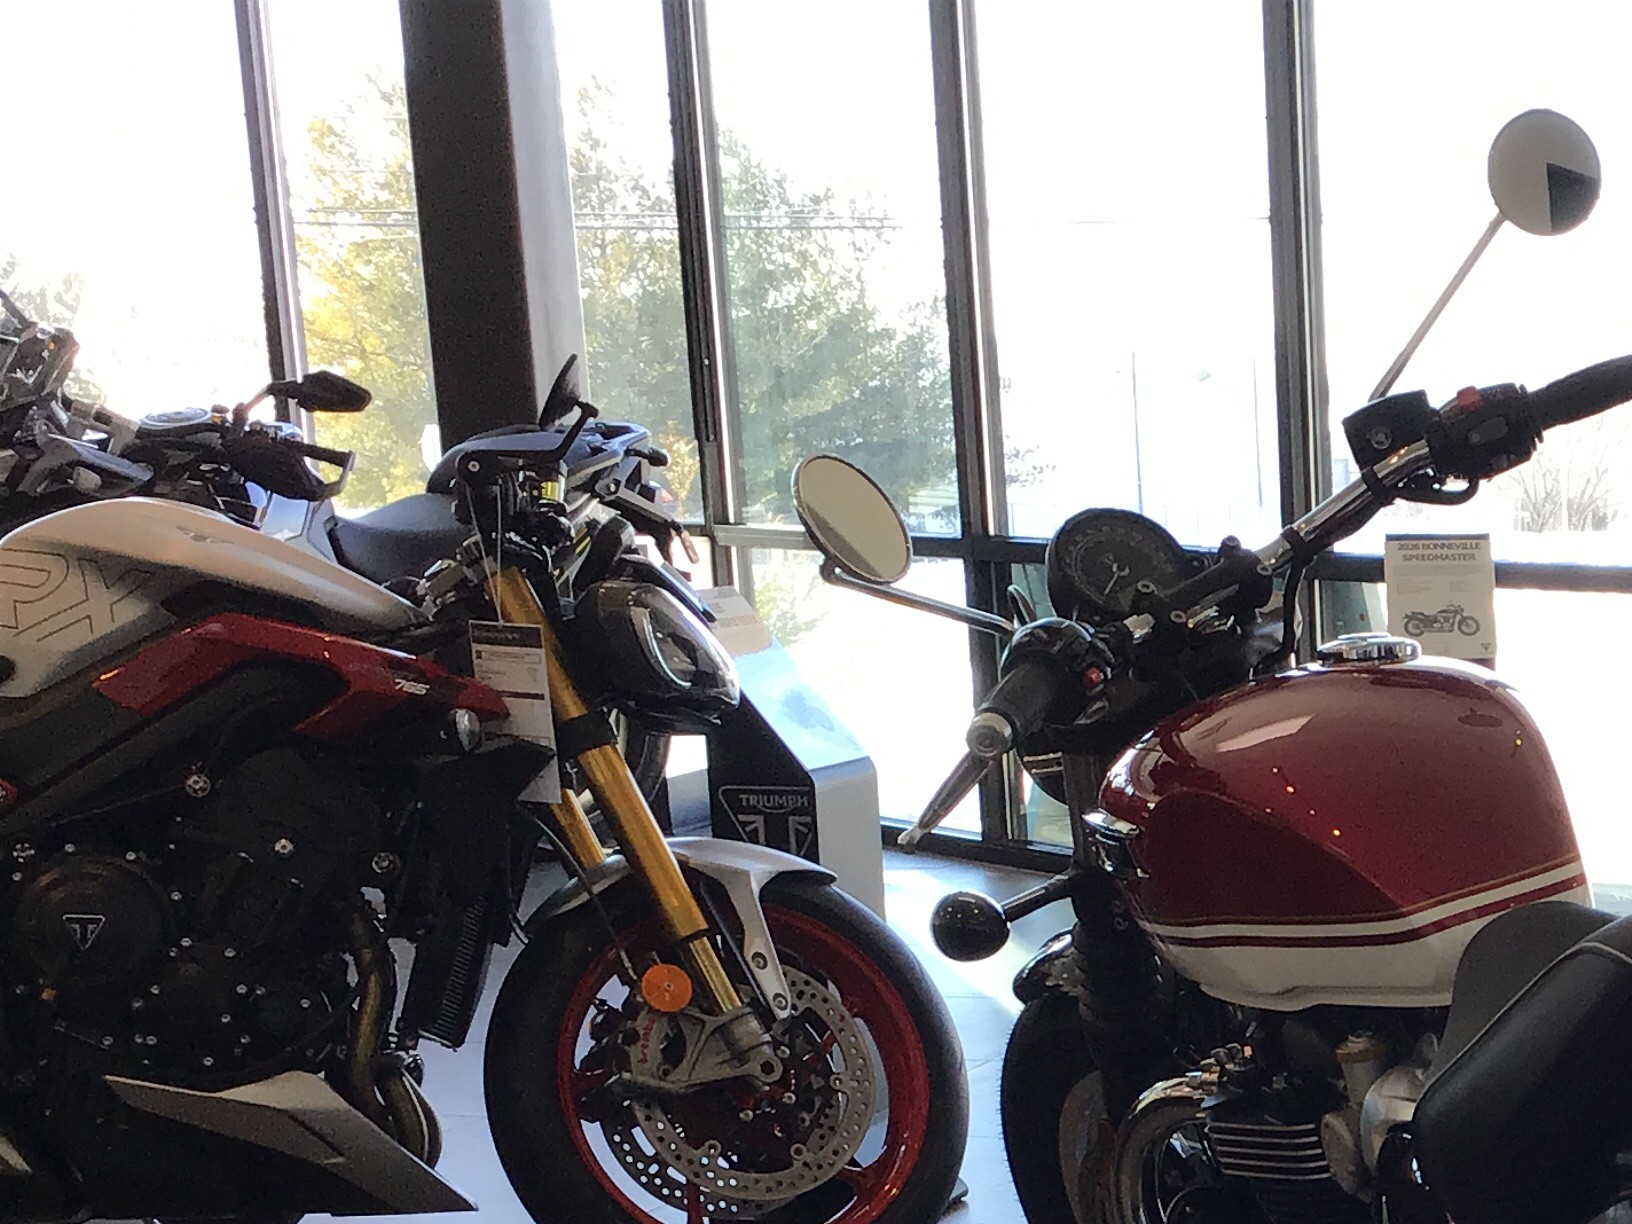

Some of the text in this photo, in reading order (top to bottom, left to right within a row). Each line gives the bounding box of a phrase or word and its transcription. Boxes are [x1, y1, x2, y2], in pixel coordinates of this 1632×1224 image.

[1422, 542, 1482, 551] BONNEVILLE
[1402, 553, 1476, 562] SPEEDMASTER
[394, 678, 431, 695] 765
[739, 794, 809, 808] TRIUMPH
